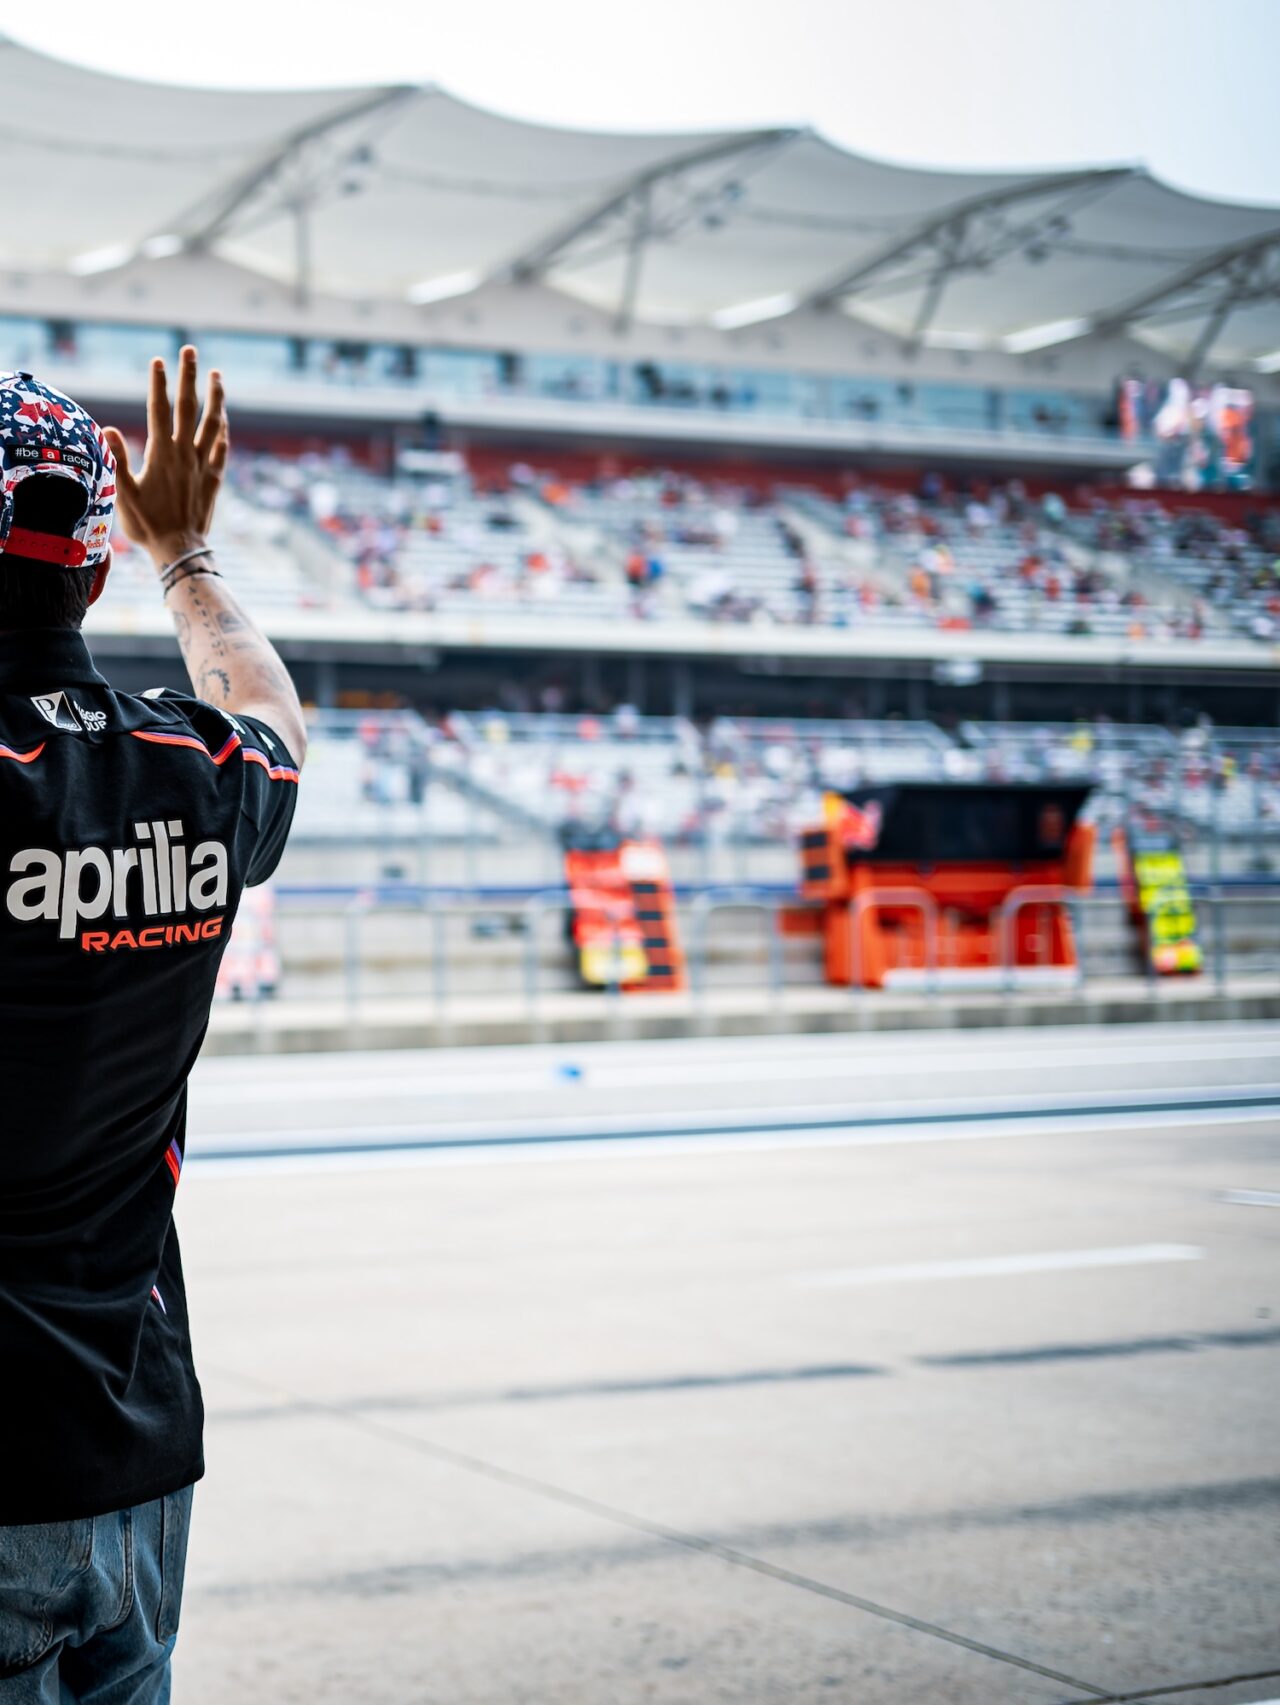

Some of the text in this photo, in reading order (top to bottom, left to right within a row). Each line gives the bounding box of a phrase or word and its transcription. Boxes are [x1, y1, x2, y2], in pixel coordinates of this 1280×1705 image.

[15, 447, 91, 468] #be a racer
[5, 819, 228, 940] aprilia
[80, 916, 225, 952] RACING
